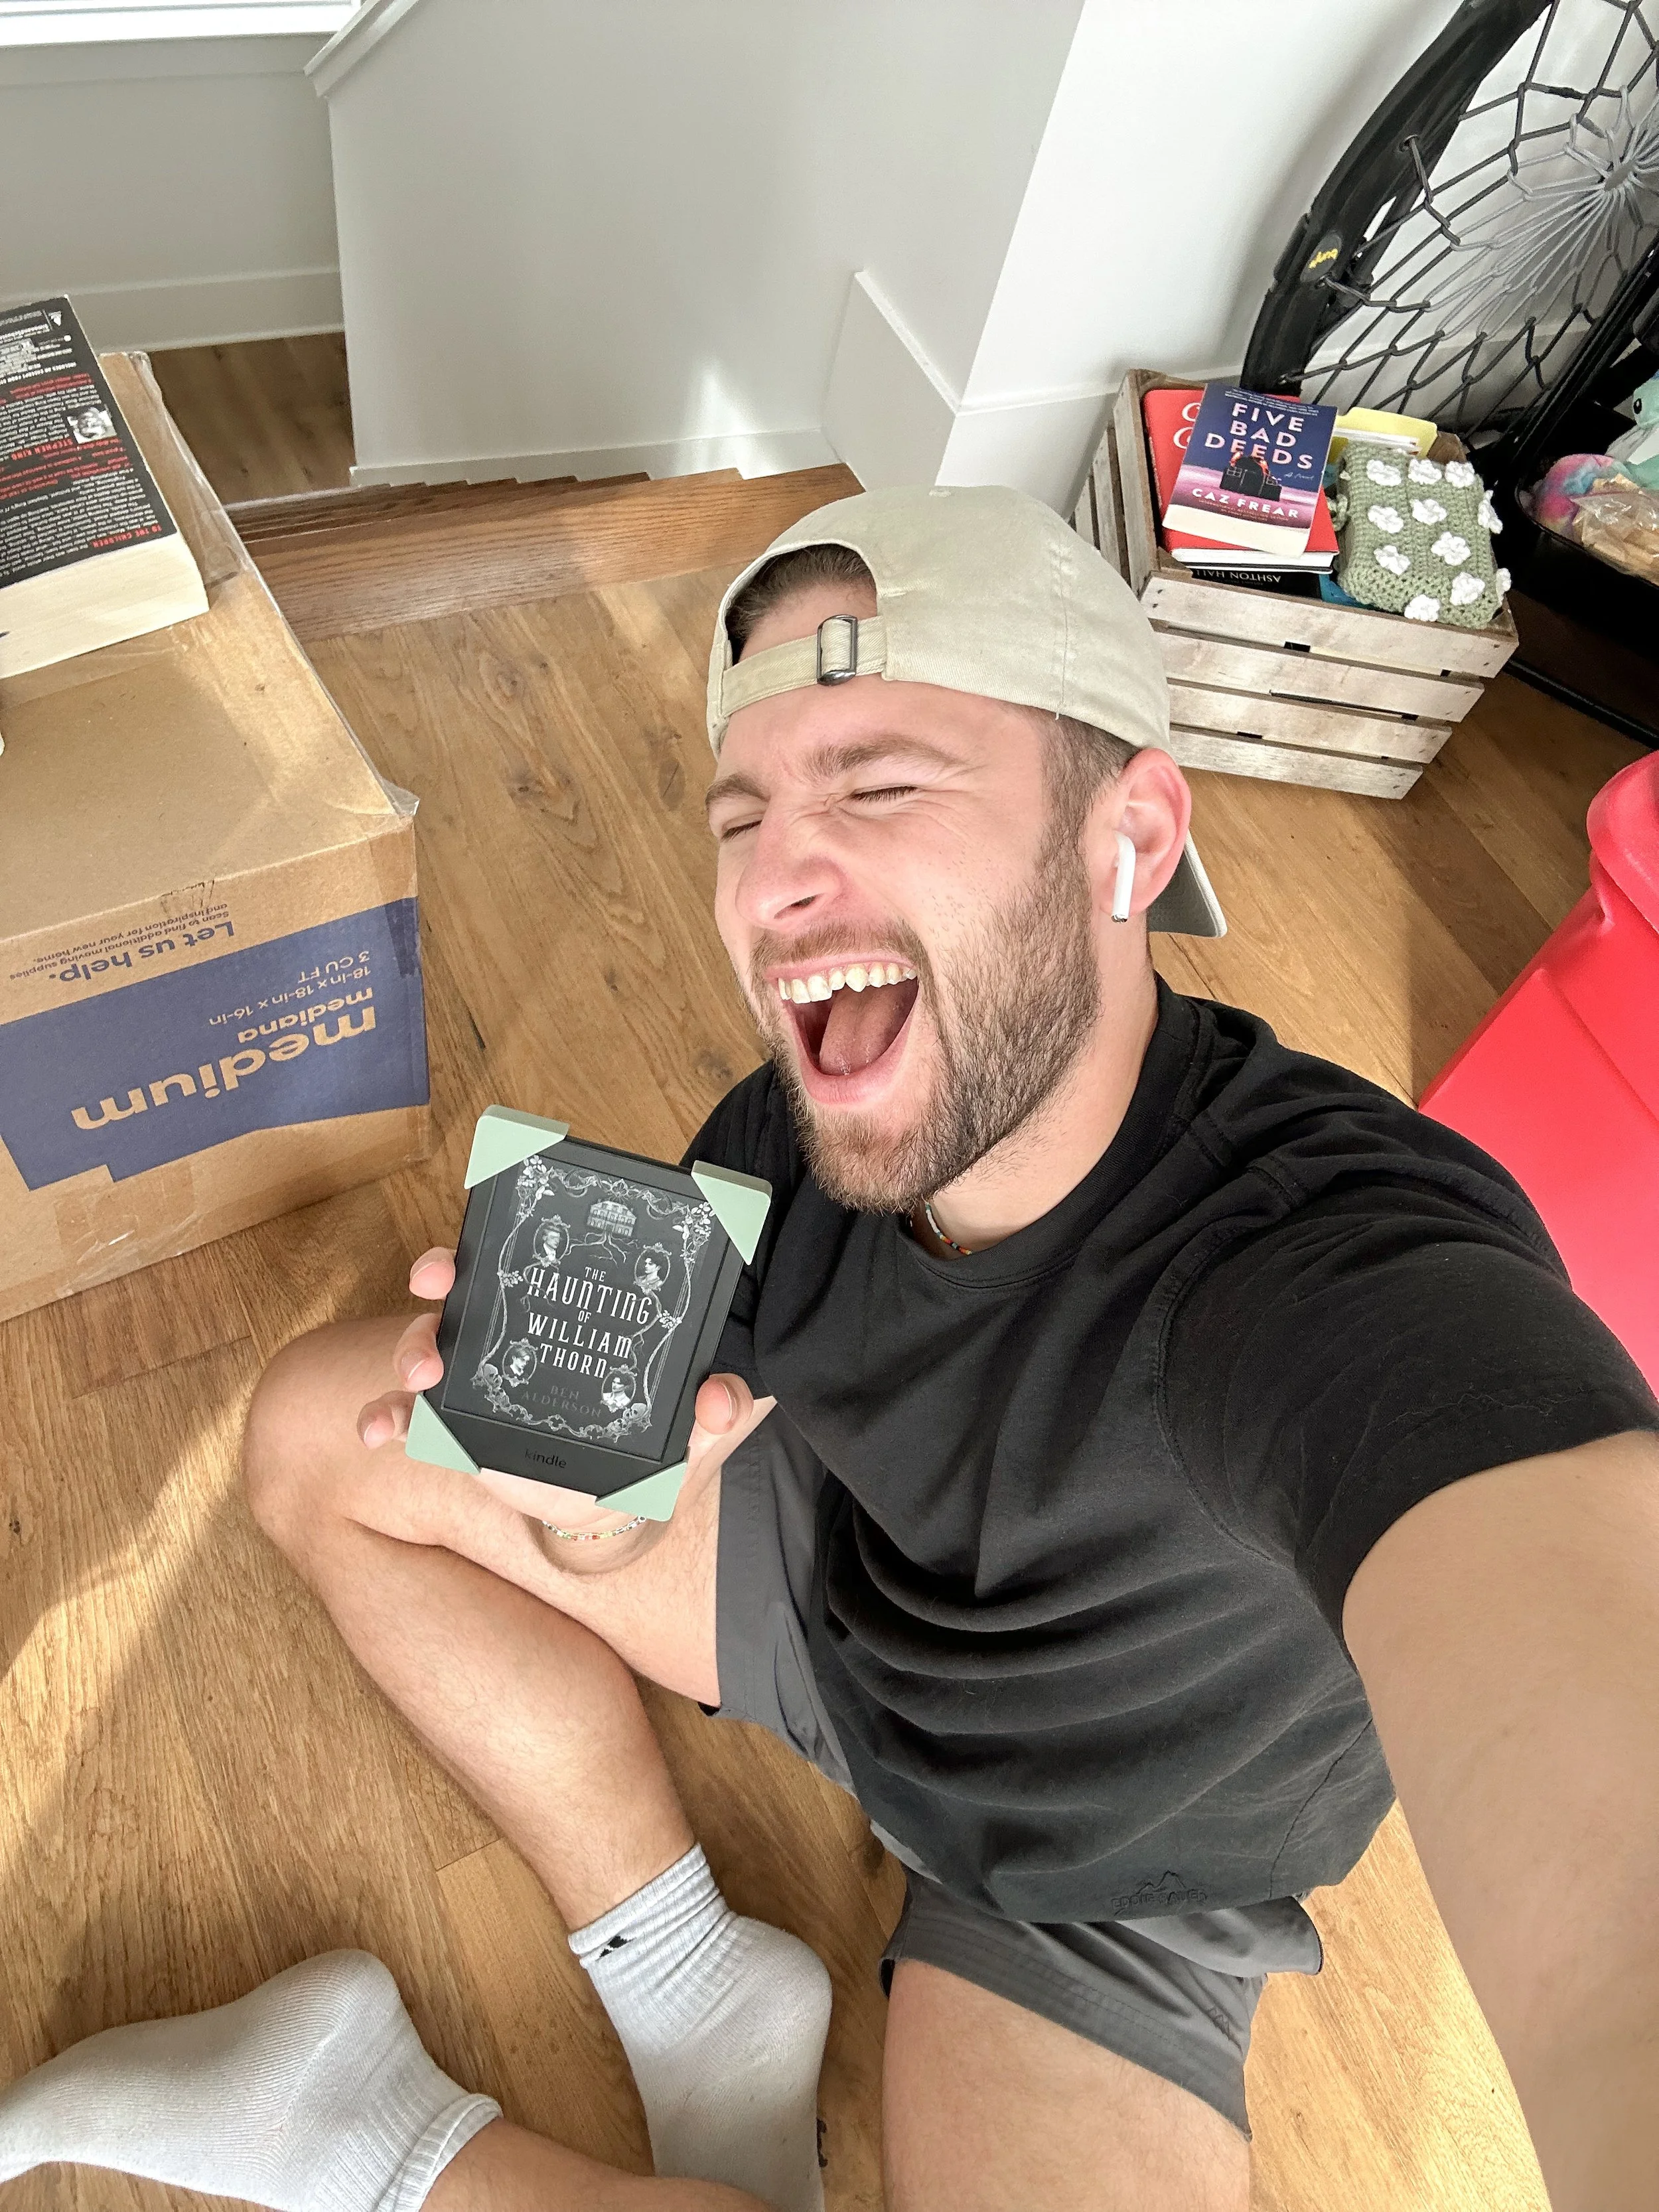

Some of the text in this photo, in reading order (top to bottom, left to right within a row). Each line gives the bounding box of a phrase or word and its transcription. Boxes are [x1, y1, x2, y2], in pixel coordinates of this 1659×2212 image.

[1232, 402, 1305, 432] FIVE
[35, 438, 73, 453] STEPHEN
[1230, 420, 1296, 447] BAD
[1204, 433, 1313, 470] DEEDS
[1192, 488, 1230, 504] CAZ
[1237, 498, 1299, 518] FREAR
[91, 533, 132, 548] CHILDREN
[1230, 572, 1281, 583] ASHTON
[165, 920, 187, 934] find
[202, 911, 229, 922] Scan
[33, 903, 228, 964] and inspiration for your new home.
[105, 926, 163, 952] additional
[48, 921, 234, 982] Let us help.
[60, 947, 104, 966] moving
[9, 962, 58, 981] supplies
[298, 951, 370, 984] 3 CU FT
[209, 966, 371, 1025] 18-in x 18-in x 16-in
[237, 987, 373, 1043] mediana
[71, 1005, 377, 1130] medium
[585, 1266, 607, 1282] THE
[527, 1267, 652, 1325] HAUNTING
[577, 1310, 592, 1323] OF
[528, 1312, 632, 1359] WILLIAM
[540, 1343, 607, 1378] THORN
[522, 1390, 601, 1418] ALDERSON
[550, 1385, 579, 1401] BEN
[525, 1449, 567, 1469] kindle
